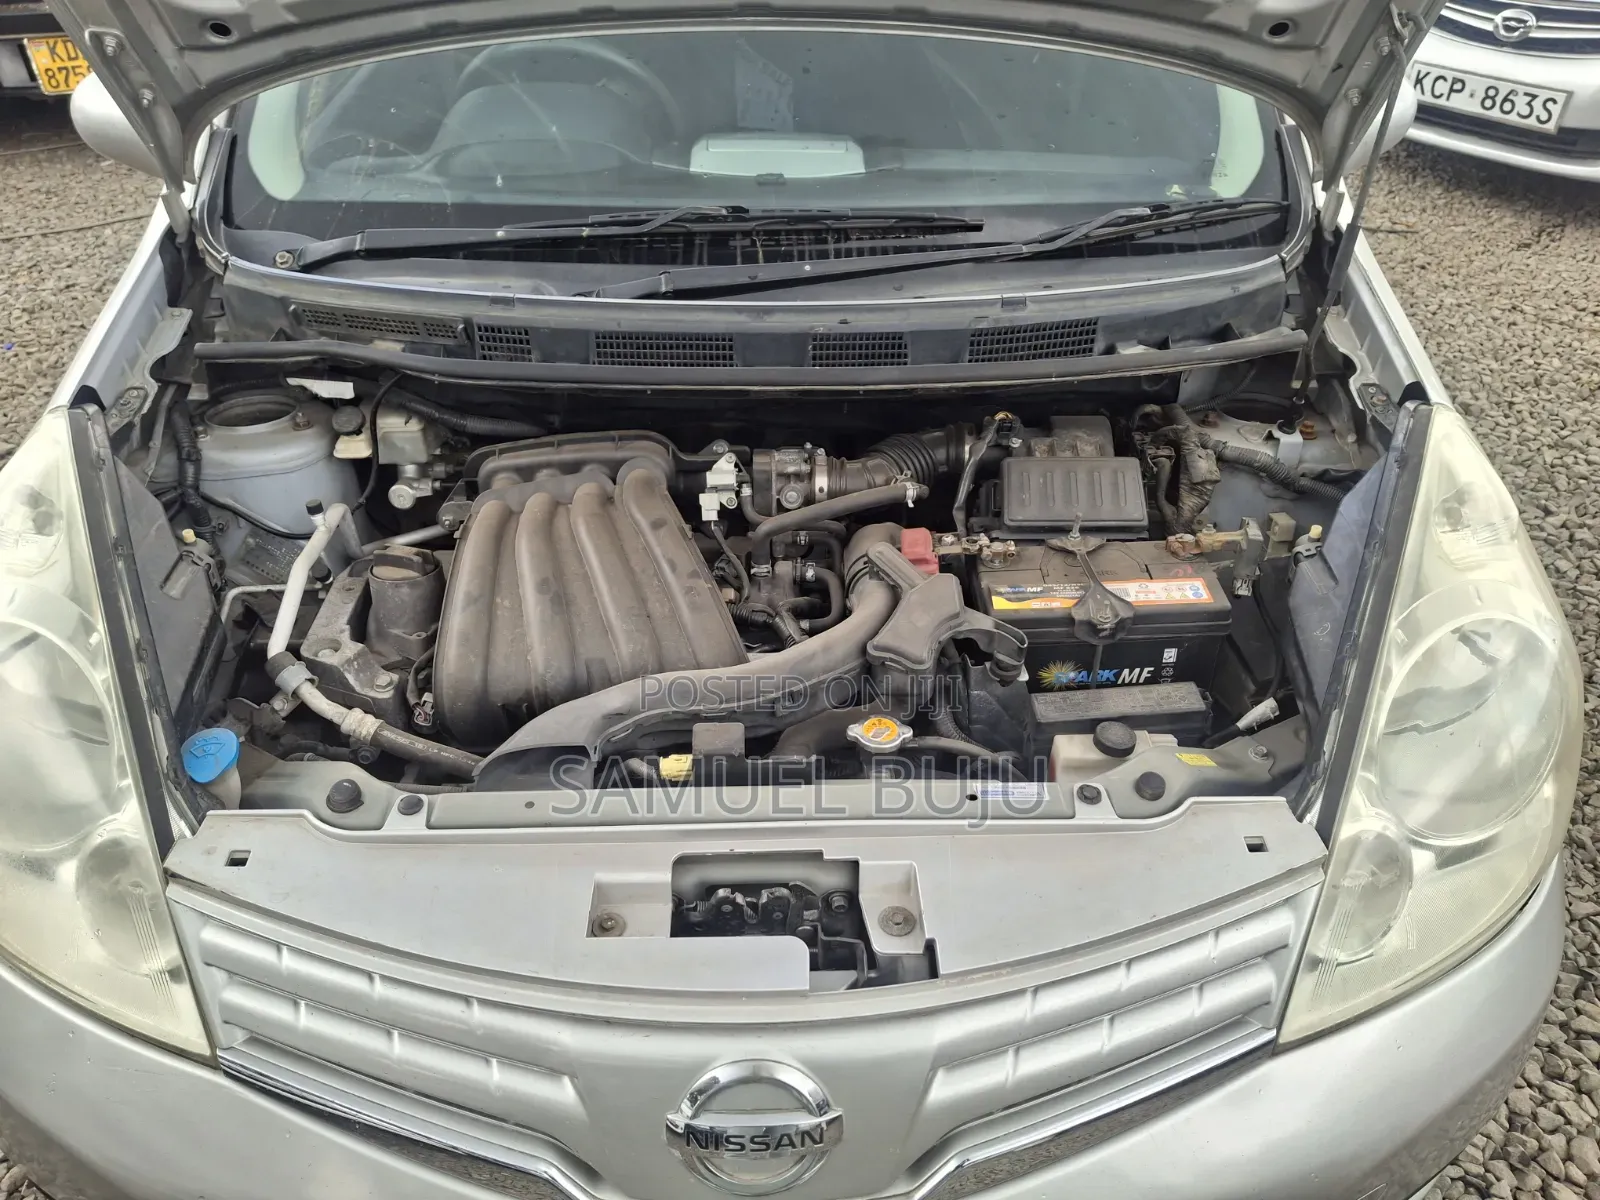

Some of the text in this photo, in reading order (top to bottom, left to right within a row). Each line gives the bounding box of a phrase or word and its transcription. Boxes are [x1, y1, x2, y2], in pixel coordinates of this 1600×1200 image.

[1413, 69, 1558, 125] KCP 863S
[1117, 667, 1155, 684] MF
[686, 1129, 824, 1152] NISSAN
